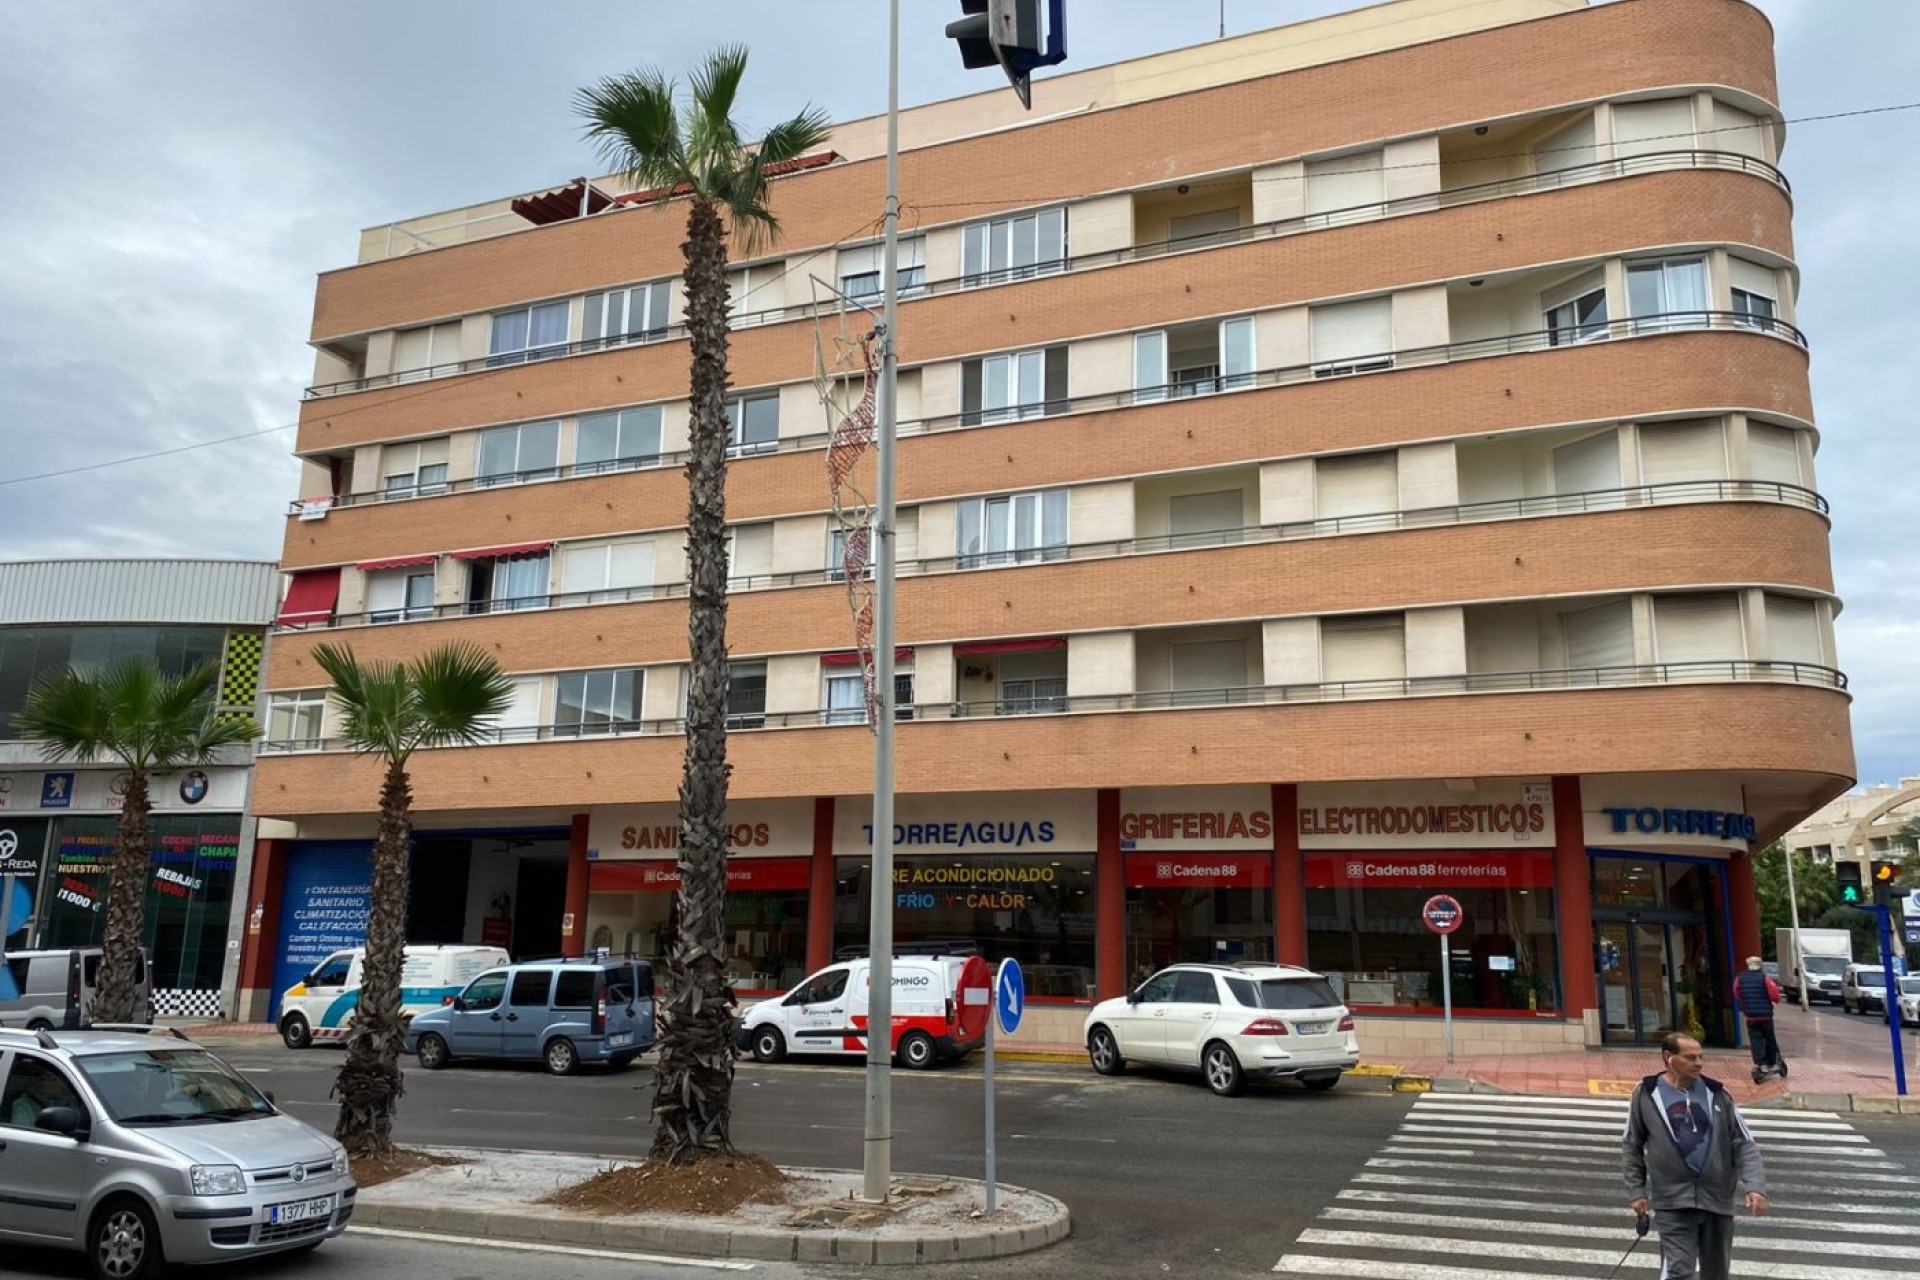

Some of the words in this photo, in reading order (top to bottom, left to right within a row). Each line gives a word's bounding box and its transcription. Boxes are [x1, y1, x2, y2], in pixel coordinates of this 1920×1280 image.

[1121, 811, 1271, 839] GRIFERIAS
[1300, 804, 1544, 834] ELECTRODOMESTICOS
[621, 823, 769, 849] SANIIOS
[200, 846, 237, 857] CHAPA
[156, 867, 202, 889] REBAJAS
[892, 868, 908, 882] RE
[912, 867, 1054, 882] ACONDICIONADO
[307, 897, 364, 907] SANITARIO
[966, 893, 1026, 908] CALOR
[890, 976, 929, 987] OMINGO
[281, 1203, 306, 1220] 1377
